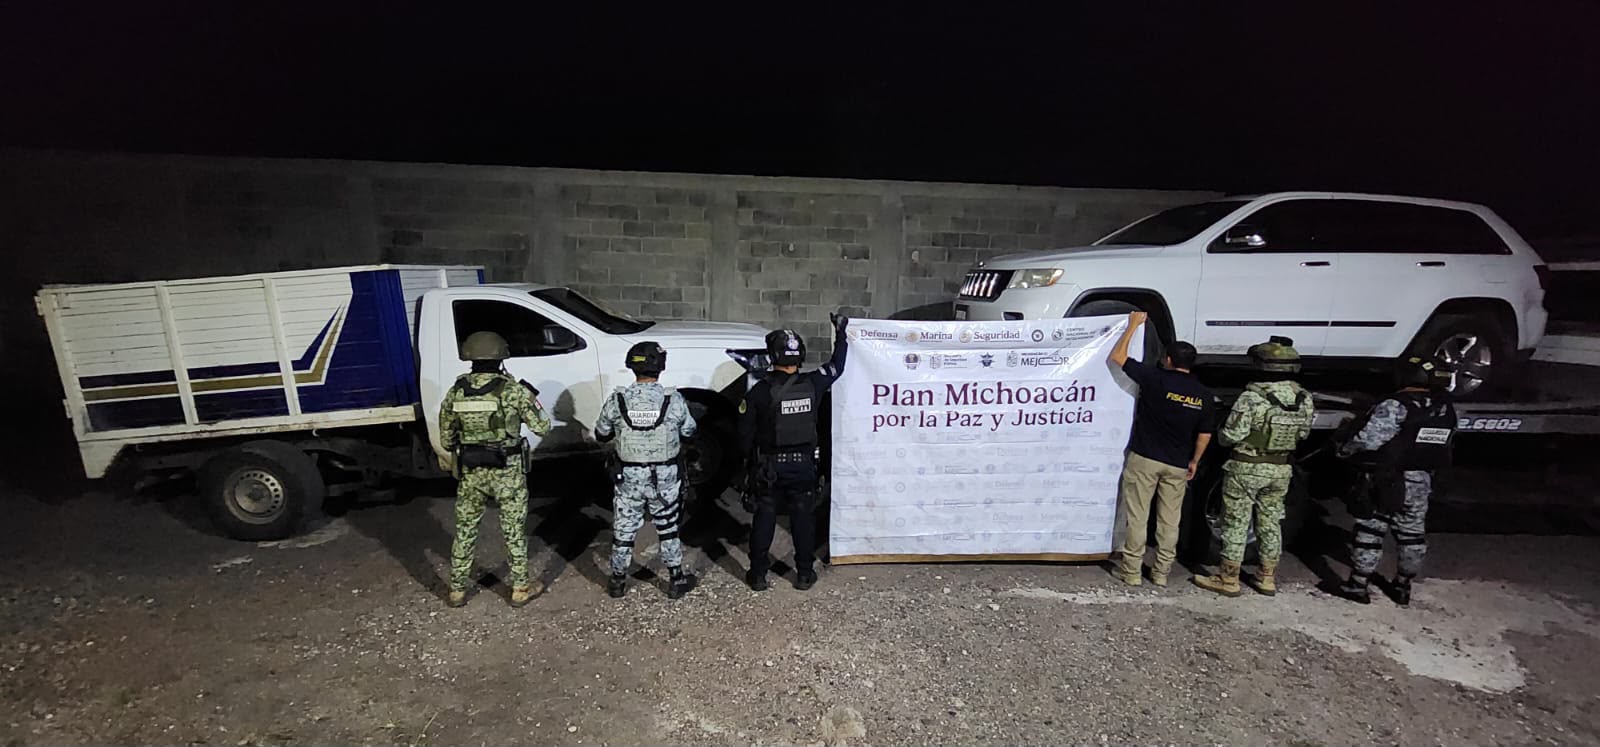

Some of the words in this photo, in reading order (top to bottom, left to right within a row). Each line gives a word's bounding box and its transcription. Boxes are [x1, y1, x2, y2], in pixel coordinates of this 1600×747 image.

[860, 329, 898, 338] Defensa
[920, 331, 953, 340] Marina
[974, 330, 1020, 341] Seguridad
[872, 383, 934, 406] Plan
[945, 380, 1096, 406] Michoacán
[1166, 392, 1203, 406] FISCALÍA
[872, 413, 911, 432] por
[919, 410, 937, 428] la
[946, 411, 983, 428] Paz
[991, 413, 1005, 431] y
[1012, 407, 1094, 426] Justicia
